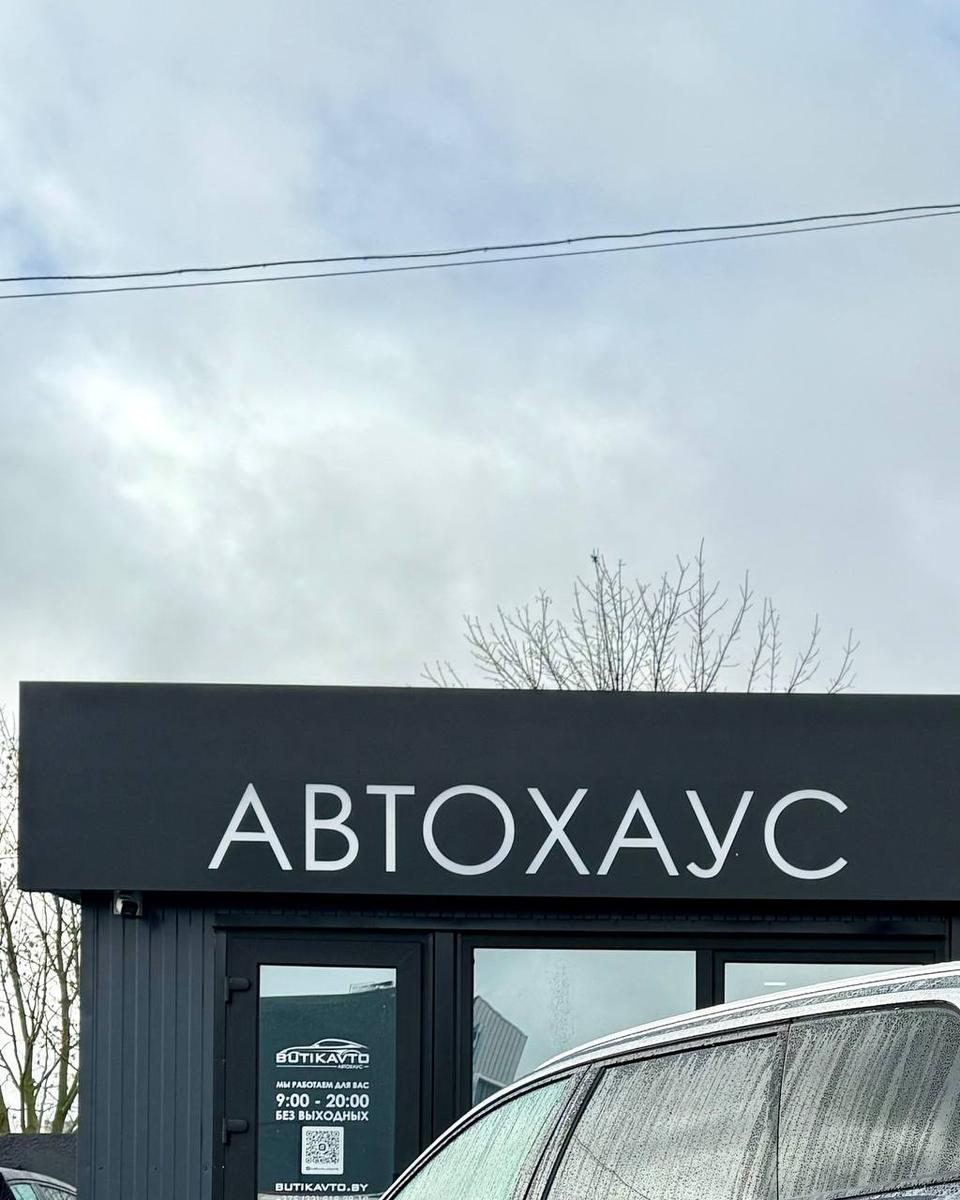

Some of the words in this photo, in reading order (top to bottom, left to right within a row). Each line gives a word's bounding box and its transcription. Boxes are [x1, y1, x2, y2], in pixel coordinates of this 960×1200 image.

[208, 783, 848, 880] АВТОХАУС
[276, 1053, 370, 1064] BUTIKAVTO
[276, 1081, 291, 1089] МЫ
[292, 1081, 334, 1089] РАБОТАЕМ
[334, 1081, 352, 1090] ДЛЯ
[275, 1093, 310, 1108] 9:00
[325, 1093, 370, 1108] 20:00
[275, 1110, 296, 1121] БЕЗ
[298, 1110, 369, 1122] ВЫХОДНЫХ
[275, 1183, 369, 1192] BUTIKAVTO.BY
